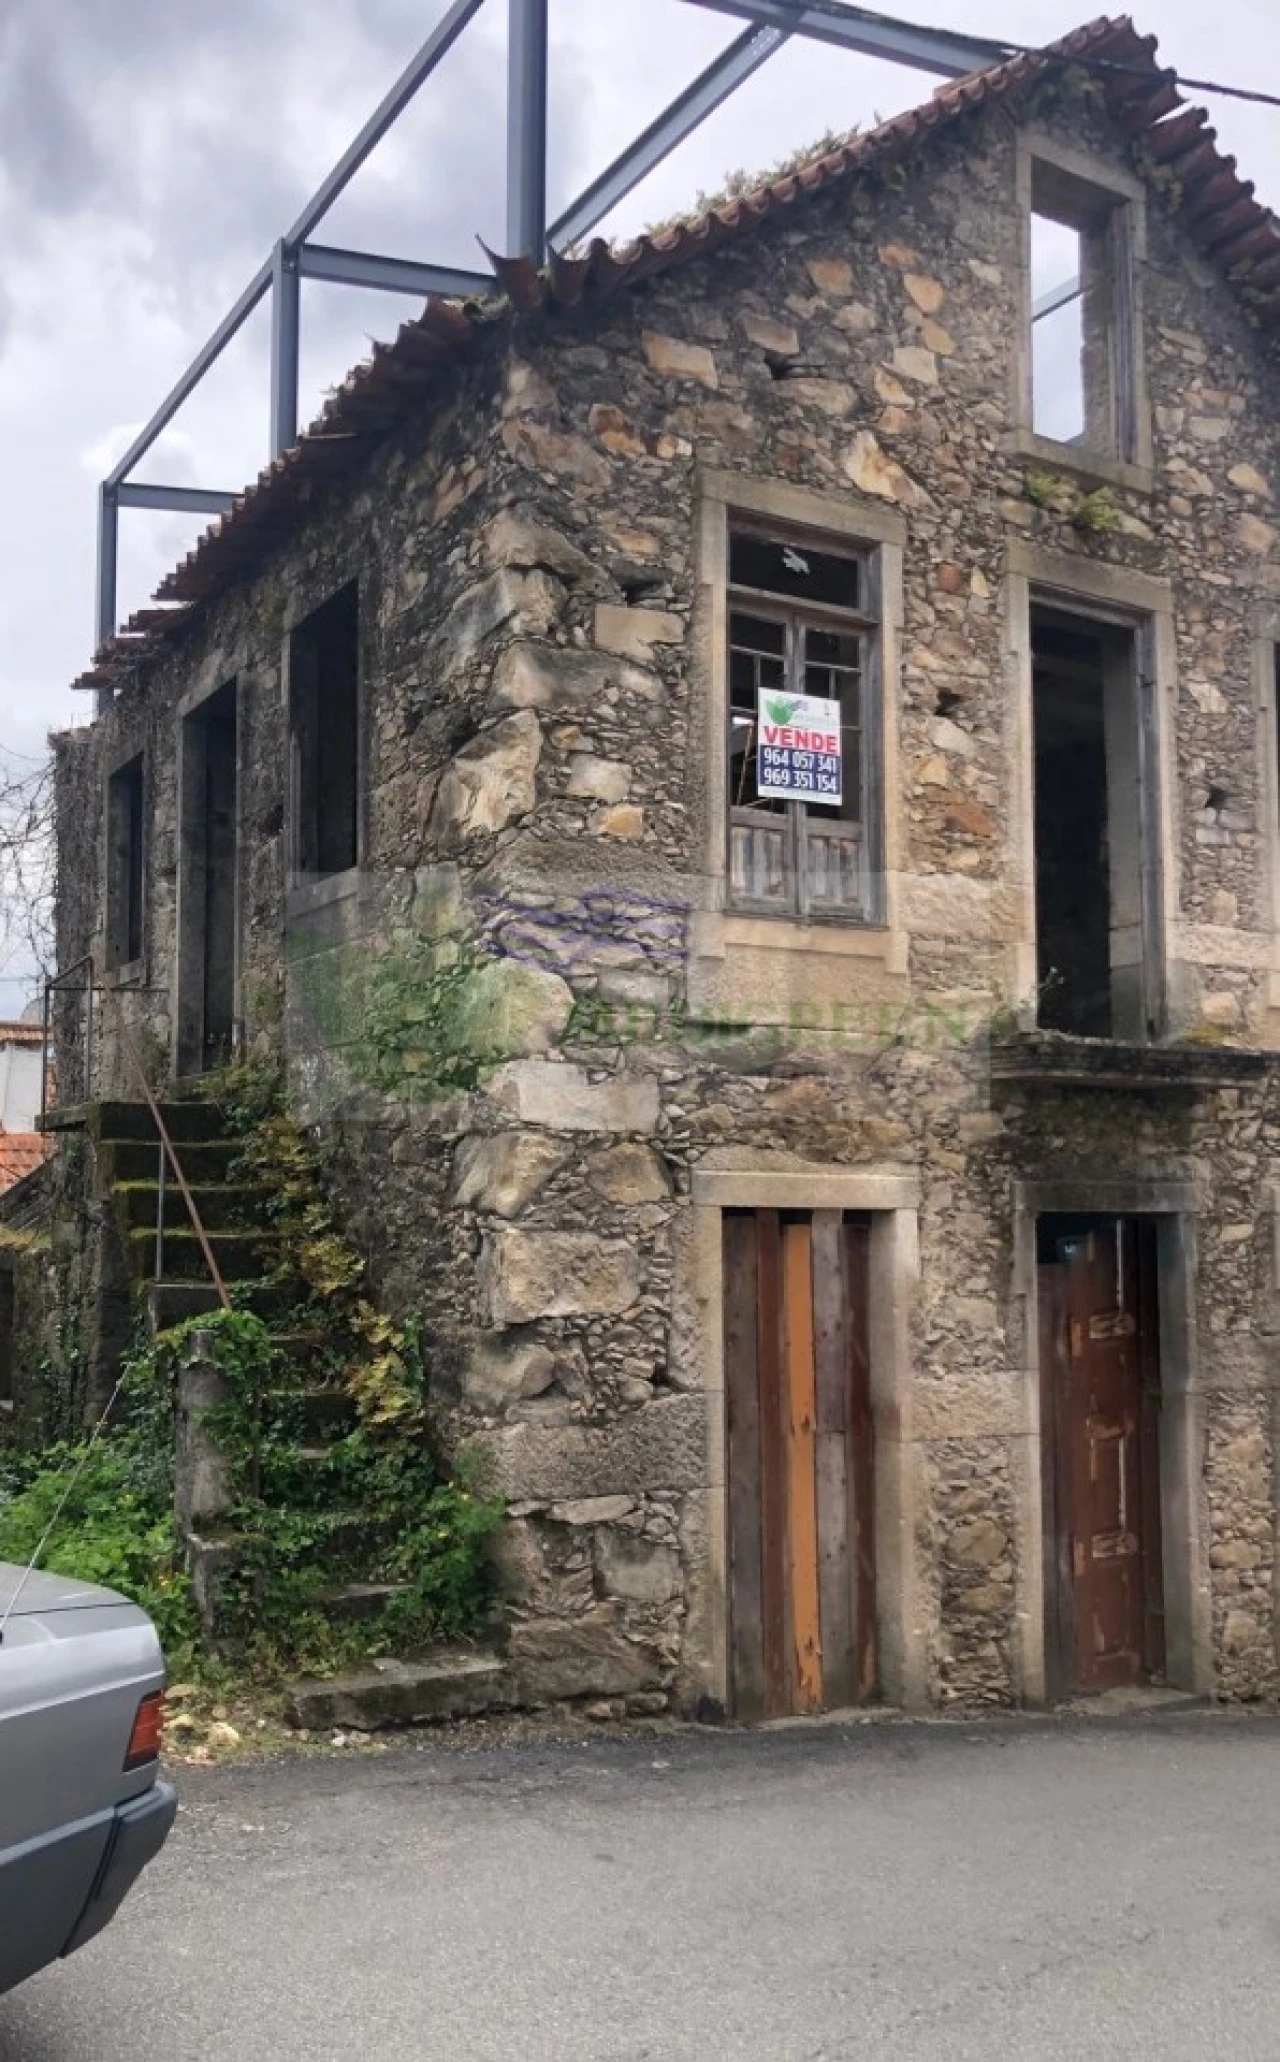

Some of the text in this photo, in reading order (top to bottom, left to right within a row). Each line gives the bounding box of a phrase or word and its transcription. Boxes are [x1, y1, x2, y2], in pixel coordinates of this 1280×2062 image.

[763, 726, 838, 752] VENDE
[764, 747, 789, 767] 964
[792, 751, 815, 769] 057
[764, 767, 789, 785] 969
[816, 774, 837, 793] 154
